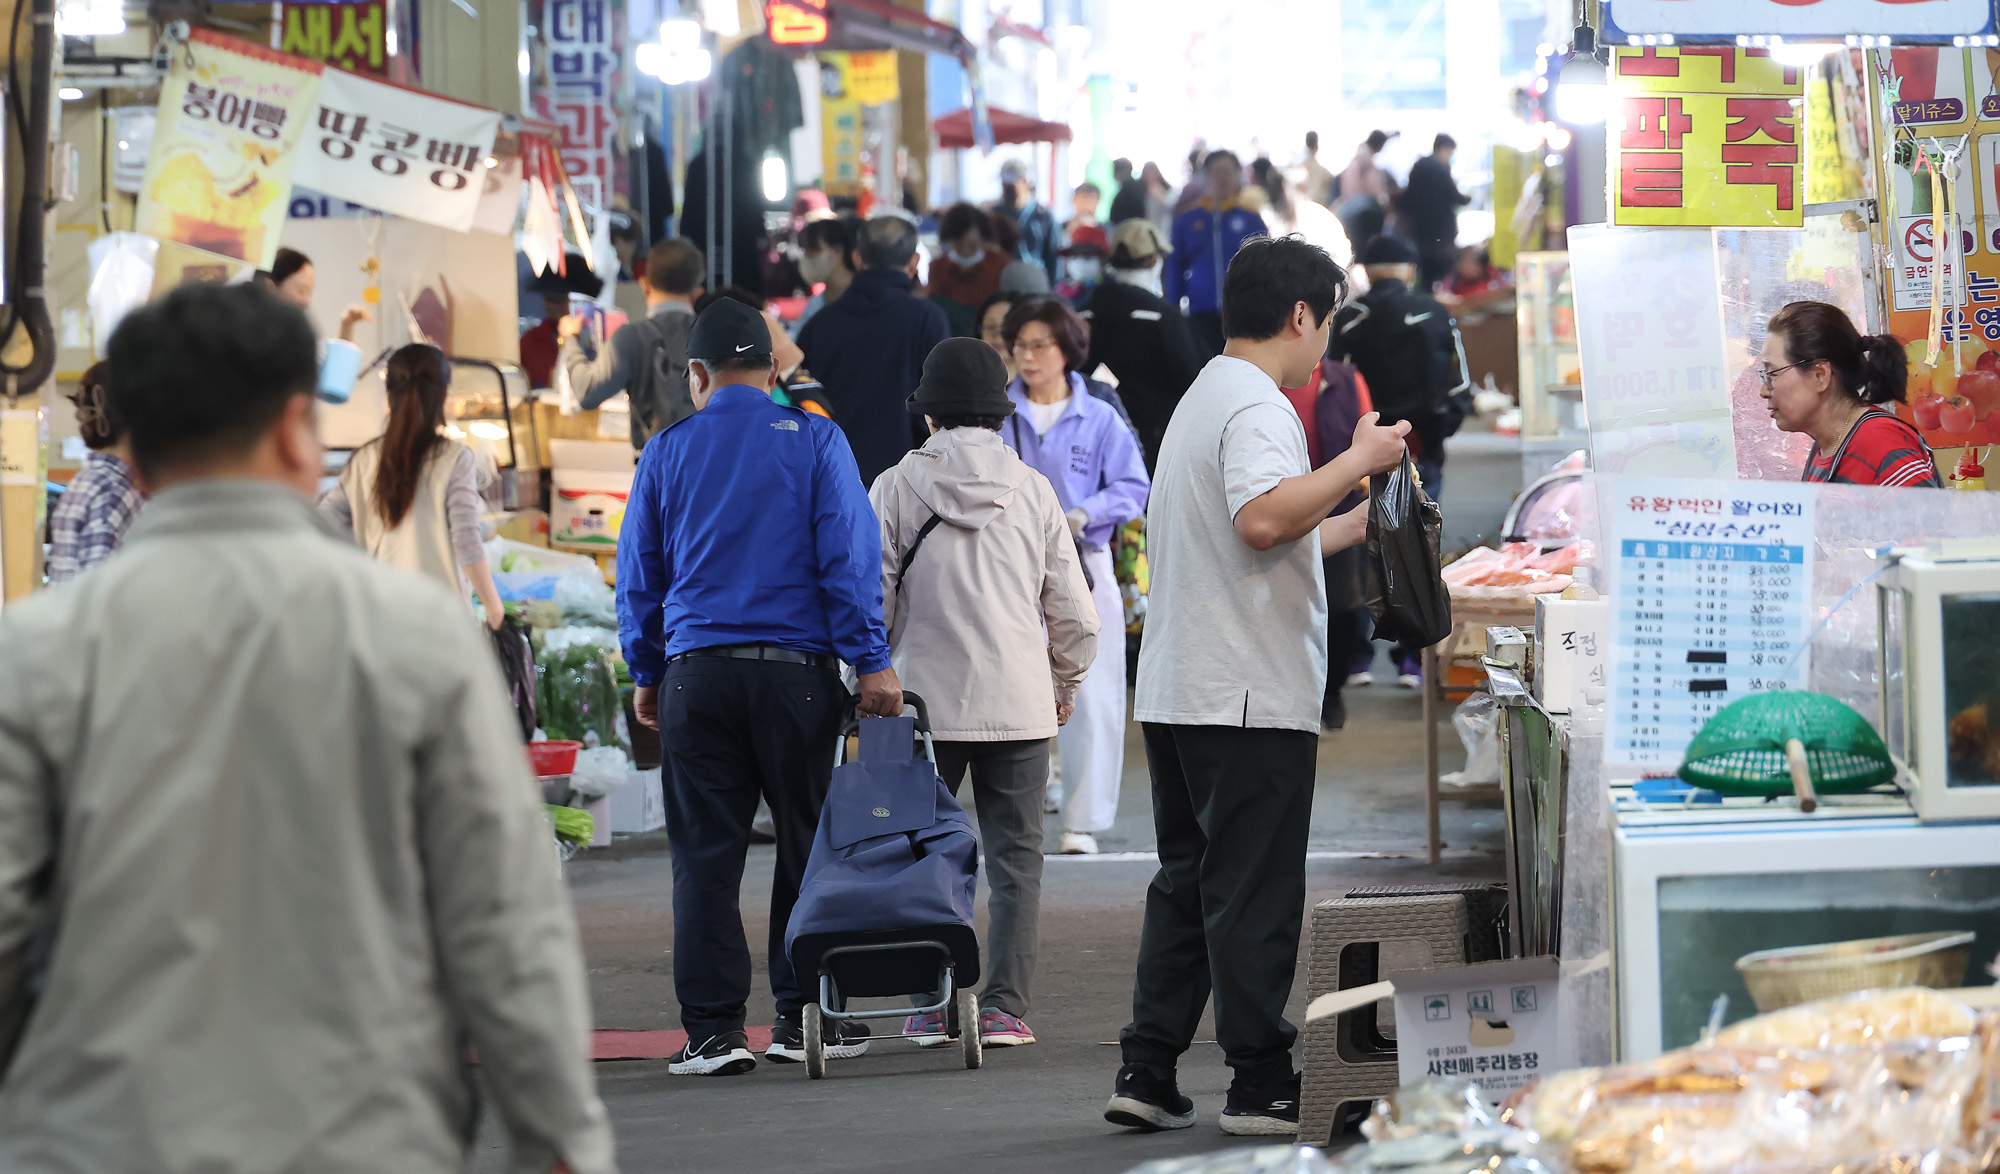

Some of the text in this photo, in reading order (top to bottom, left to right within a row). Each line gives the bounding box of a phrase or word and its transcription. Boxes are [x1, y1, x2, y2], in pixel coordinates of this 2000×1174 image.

[181, 80, 290, 141] 붕어빵
[1897, 98, 2000, 121] 딸기쥬스 오
[317, 103, 481, 193] 땅콩빵
[1620, 97, 1798, 211] 팥죽
[1905, 263, 1953, 279] 금연역
[1626, 495, 1802, 517] 유황먹인 활어회
[1427, 1051, 1539, 1076] 사천메추리농장
